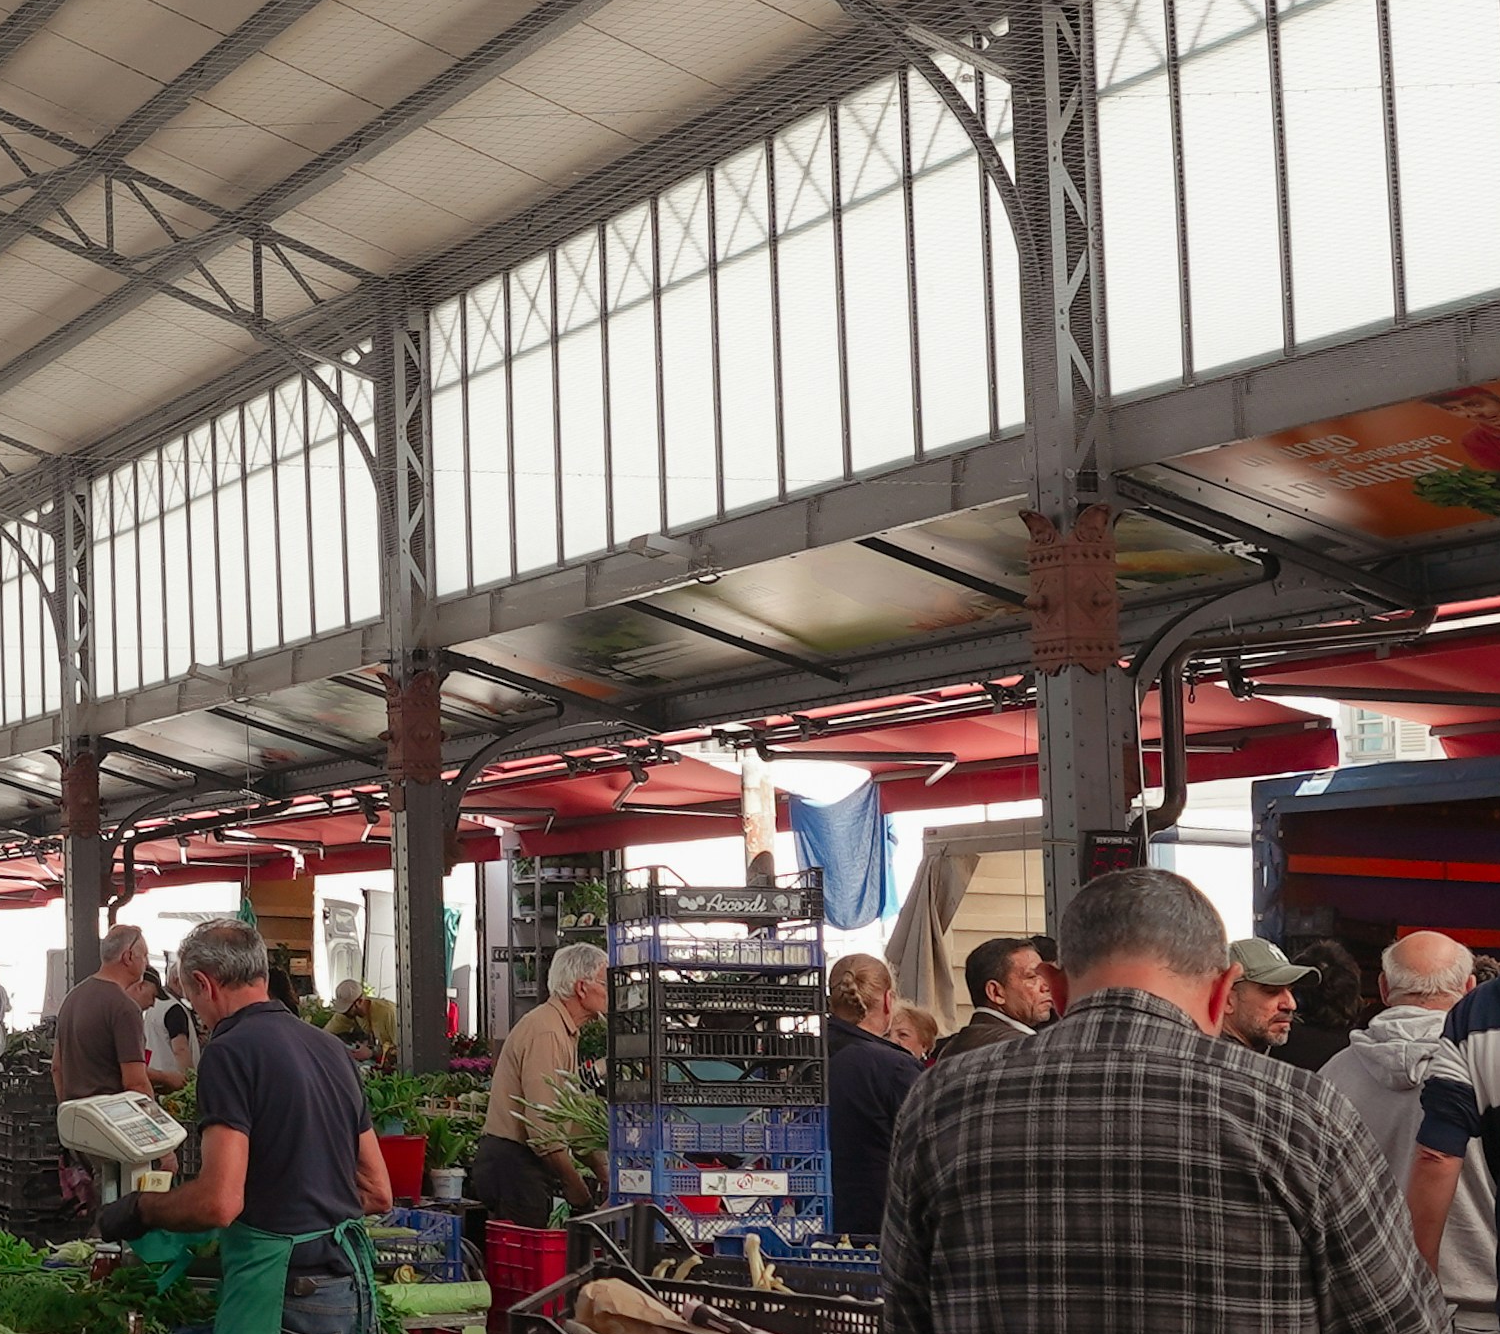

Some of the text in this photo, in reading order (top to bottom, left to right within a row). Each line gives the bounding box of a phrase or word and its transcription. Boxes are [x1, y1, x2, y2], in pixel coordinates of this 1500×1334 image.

[1344, 434, 1453, 465] conoscere
[1289, 451, 1466, 500] poduttori
[706, 893, 768, 913] Accordi
